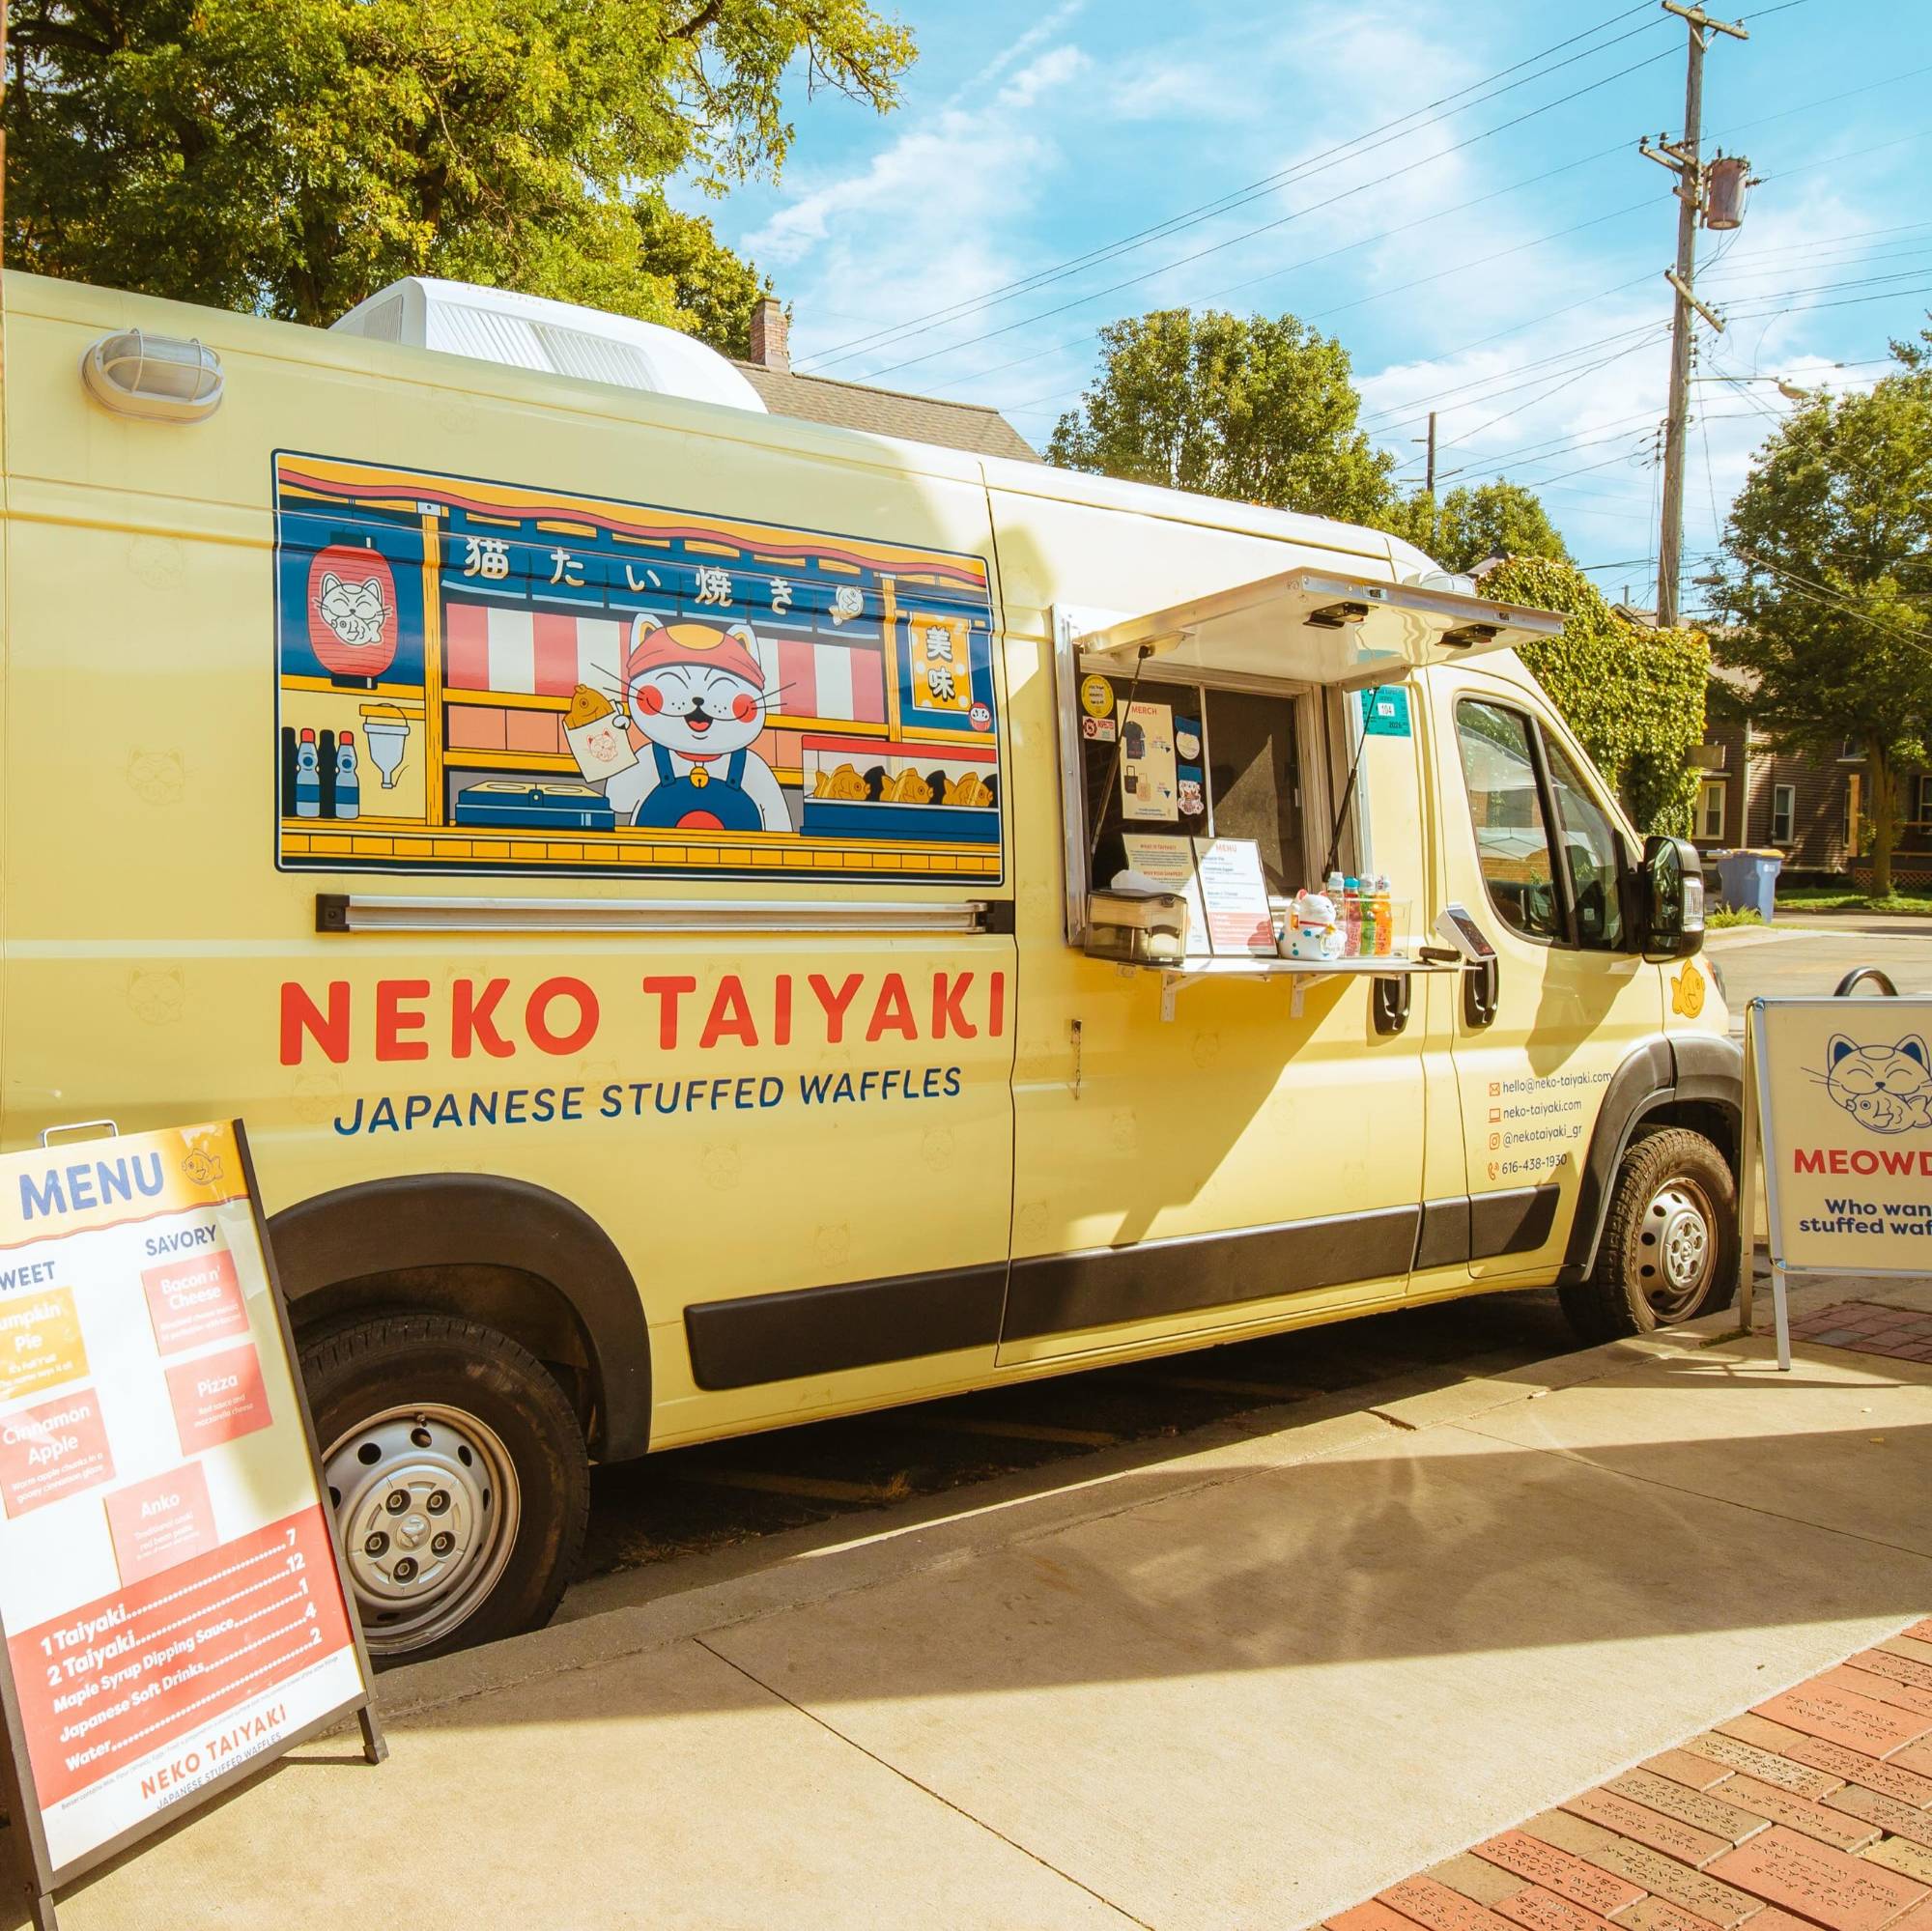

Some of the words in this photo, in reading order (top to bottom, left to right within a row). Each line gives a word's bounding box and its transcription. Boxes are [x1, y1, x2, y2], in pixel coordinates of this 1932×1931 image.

[464, 536, 794, 616] 猫たい焼き
[924, 626, 958, 700] 美味
[1132, 706, 1157, 716] MERCH
[1216, 844, 1236, 853] MENU
[280, 976, 600, 1065] NEKO
[642, 972, 1005, 1050] TAIYAKI
[1503, 1071, 1612, 1093] hello@neko-taiyaki.com
[334, 1086, 584, 1136] JAPANESE
[600, 1076, 783, 1118] STUFFED
[800, 1066, 962, 1105] WAFFLES
[1503, 1098, 1581, 1121] neko-taiyaki.com
[1503, 1124, 1582, 1149] @nekotaiyaki_gr
[1501, 1153, 1568, 1175] 616-438-1930
[18, 1151, 164, 1221] MENU
[1825, 1199, 1877, 1215] Who
[1882, 1204, 1932, 1217] wan
[1800, 1217, 1884, 1234] stuffed
[0, 1261, 55, 1291] WEET
[145, 1224, 216, 1257] SAVORY
[161, 1273, 207, 1295] Bacon
[169, 1287, 221, 1310] Cheese
[0, 1304, 61, 1330] umpkin
[14, 1333, 43, 1352] Pie
[197, 1375, 238, 1397] Pizza
[3, 1406, 90, 1445] Cinnamon
[28, 1435, 78, 1465] Apple
[141, 1494, 180, 1518] Anko
[41, 1636, 52, 1657] 1
[286, 1528, 297, 1548] 7
[46, 1664, 63, 1687] 2
[53, 1685, 99, 1714] Maple
[100, 1662, 142, 1690] Syrup
[143, 1638, 195, 1670] Dipping
[196, 1617, 235, 1643] Sauce
[60, 1699, 130, 1742] Japanese
[131, 1682, 161, 1706] Soft
[162, 1661, 205, 1691] Drinks
[65, 1741, 111, 1772] Water
[310, 1628, 323, 1645] 2
[141, 1752, 200, 1800] NEKO
[205, 1703, 287, 1761] TAIYAKI
[156, 1775, 203, 1810] JAPANESE
[205, 1754, 242, 1782] STUFFED
[244, 1732, 282, 1759] WAFFLES
